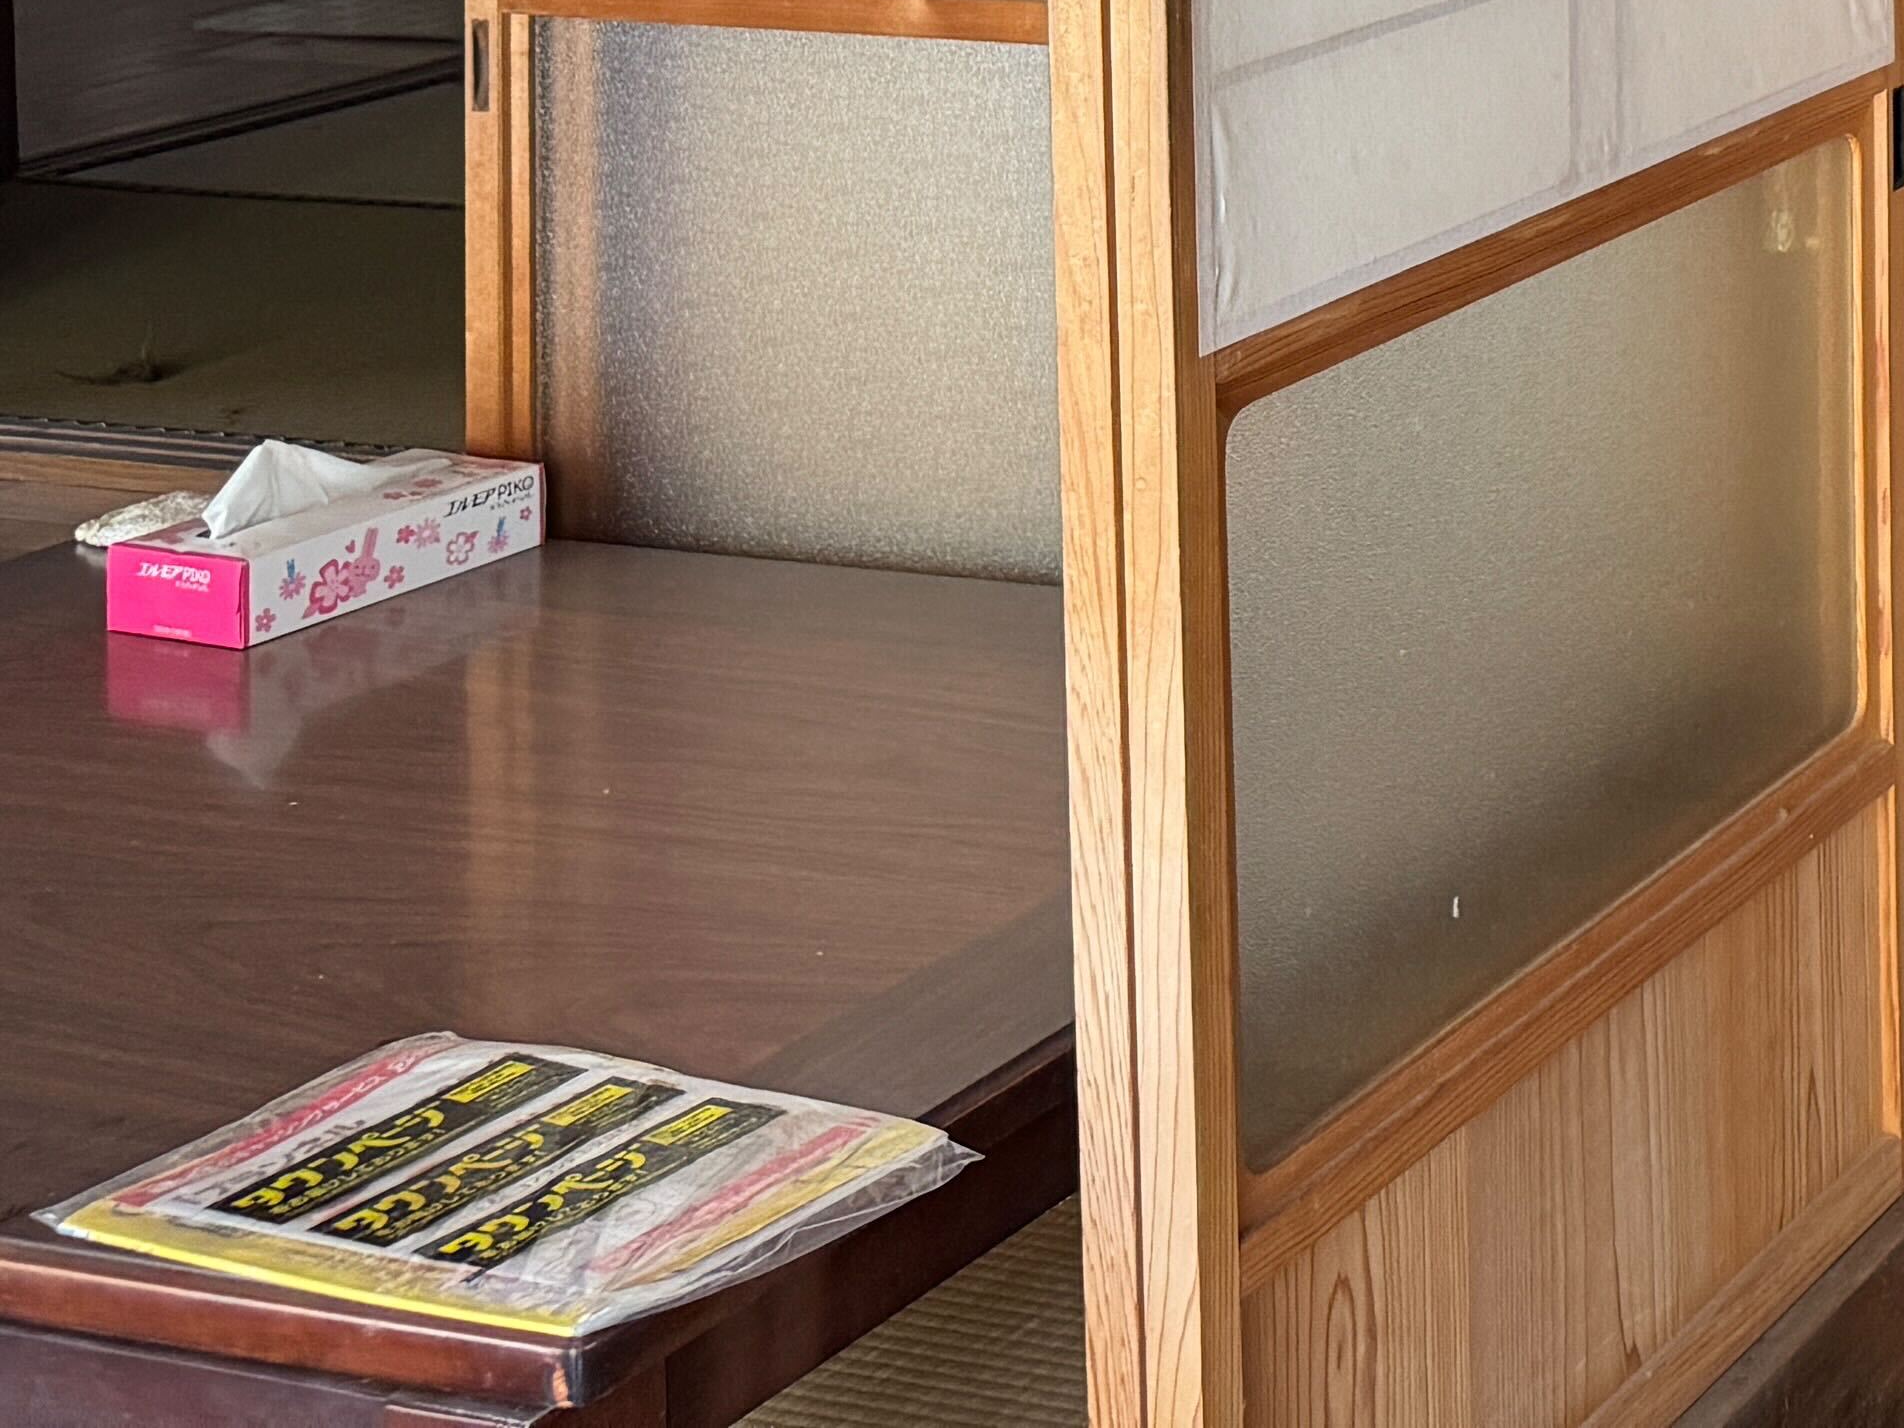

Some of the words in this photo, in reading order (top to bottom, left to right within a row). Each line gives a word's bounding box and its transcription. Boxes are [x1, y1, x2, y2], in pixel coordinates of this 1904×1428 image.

[230, 1100, 445, 1209] タウンページ
[332, 1123, 545, 1231] タウンページ
[438, 1143, 647, 1254] タウンページ
